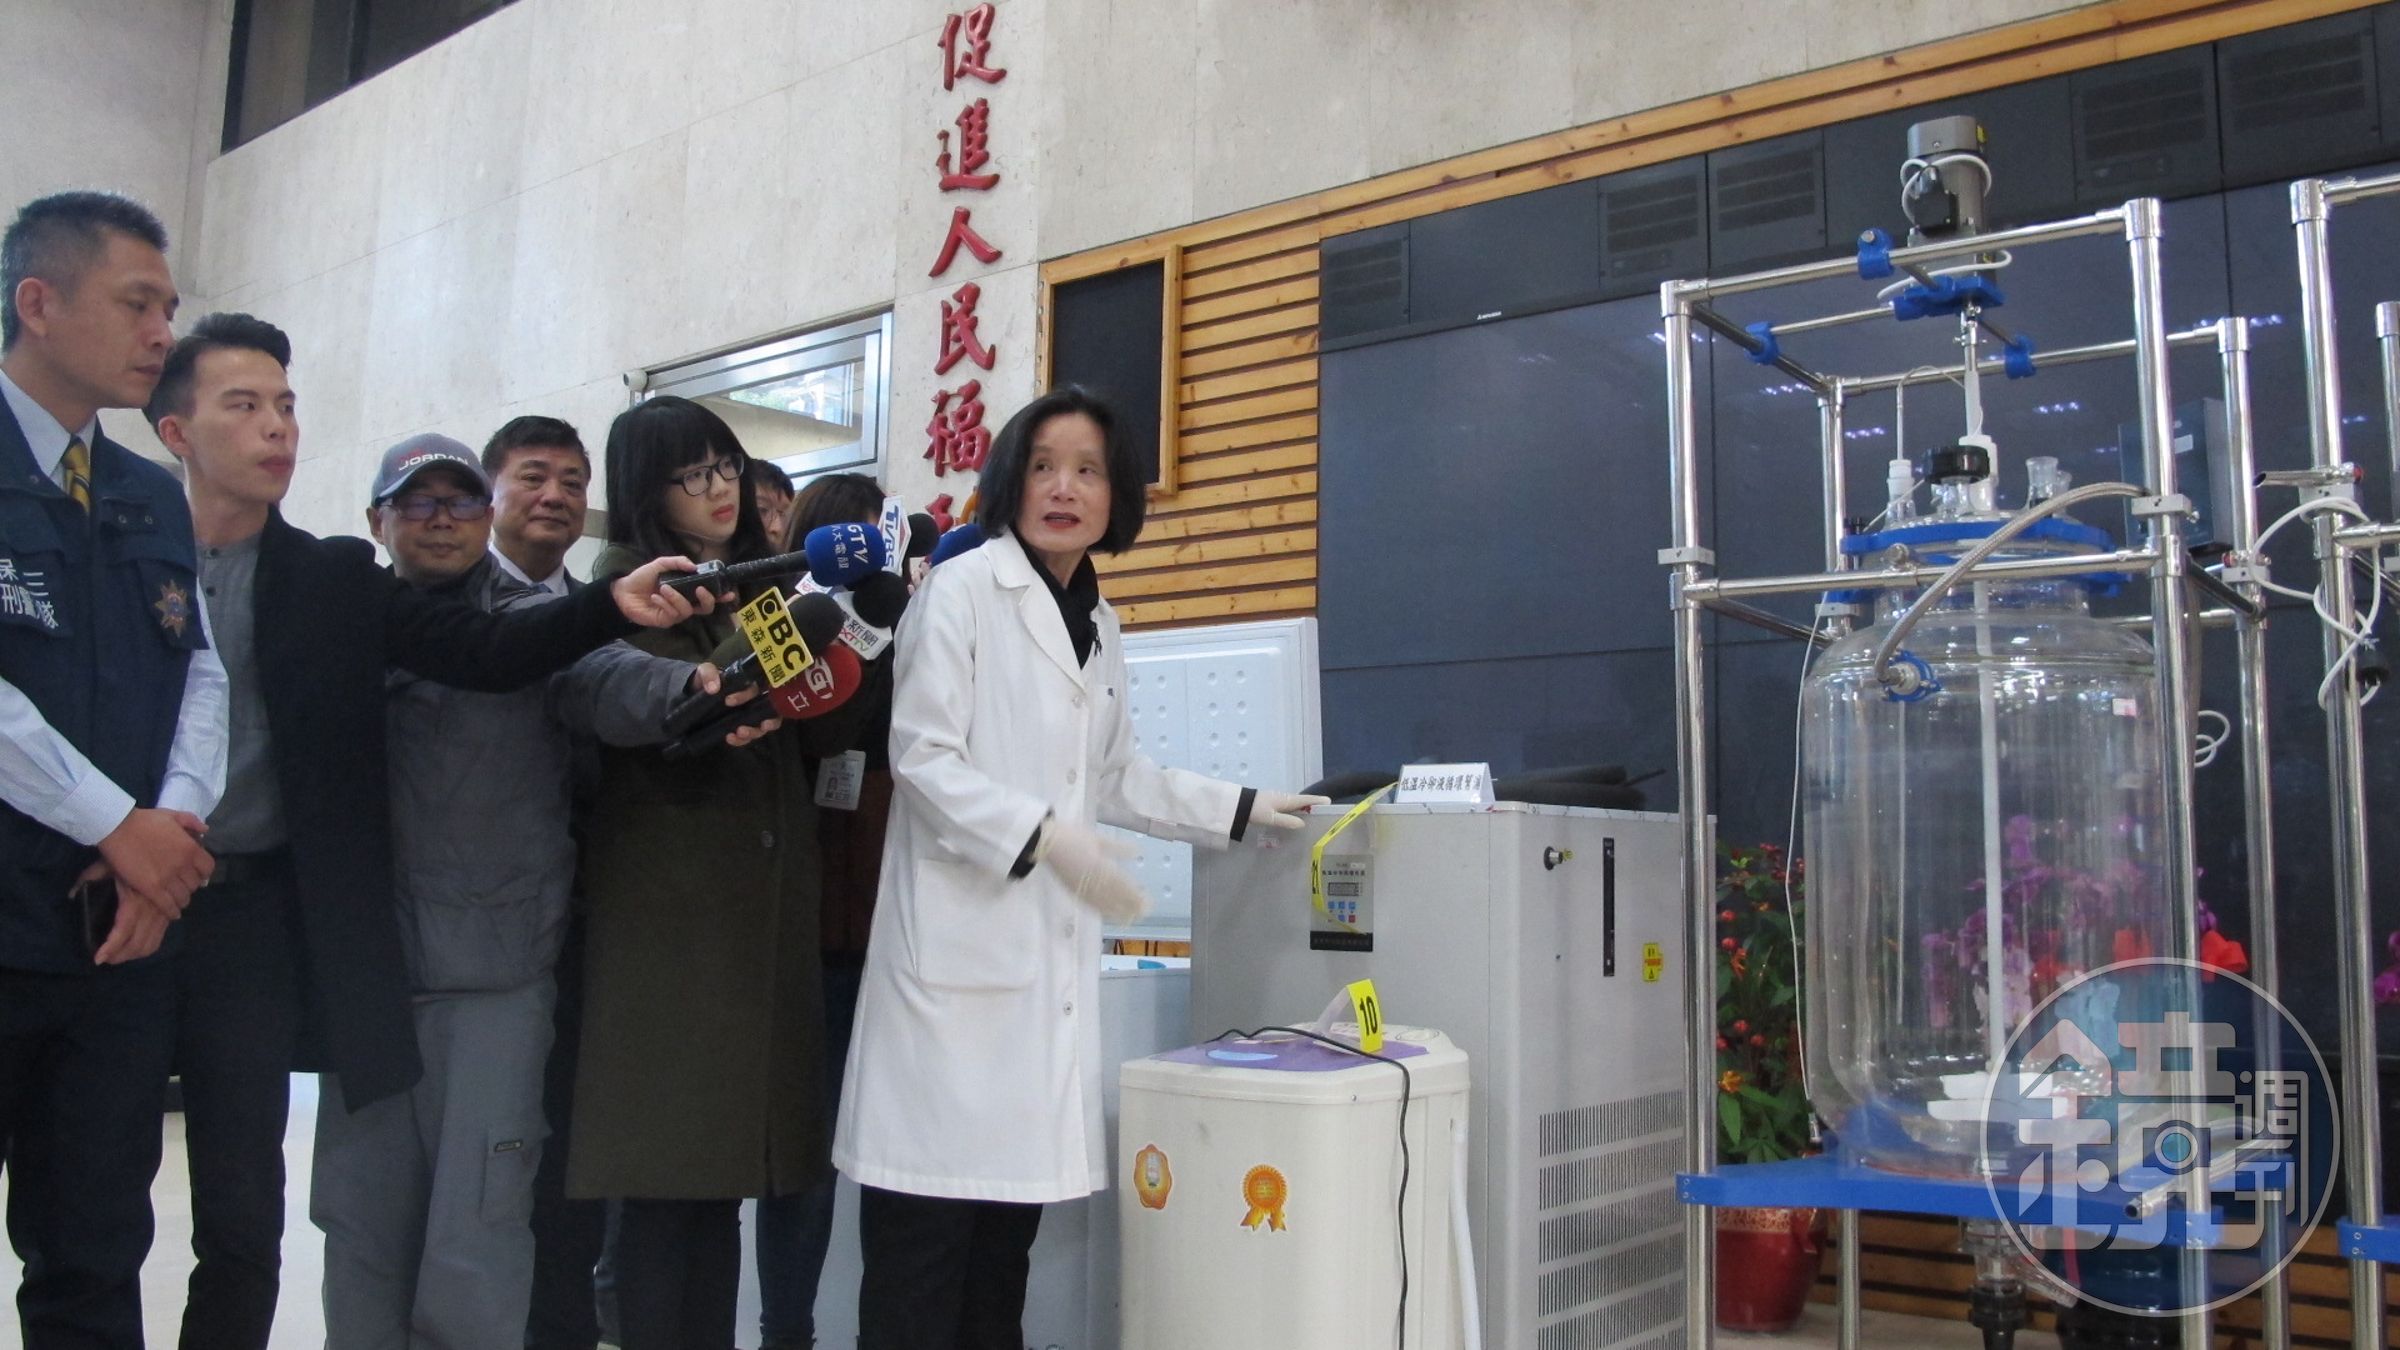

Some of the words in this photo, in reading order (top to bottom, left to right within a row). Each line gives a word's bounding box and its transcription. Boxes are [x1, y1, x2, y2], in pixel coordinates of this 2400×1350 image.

[398, 453, 469, 471] JORDAN
[847, 524, 869, 564] GTV
[741, 607, 786, 683] 東森新聞
[1359, 995, 1378, 1036] 10
